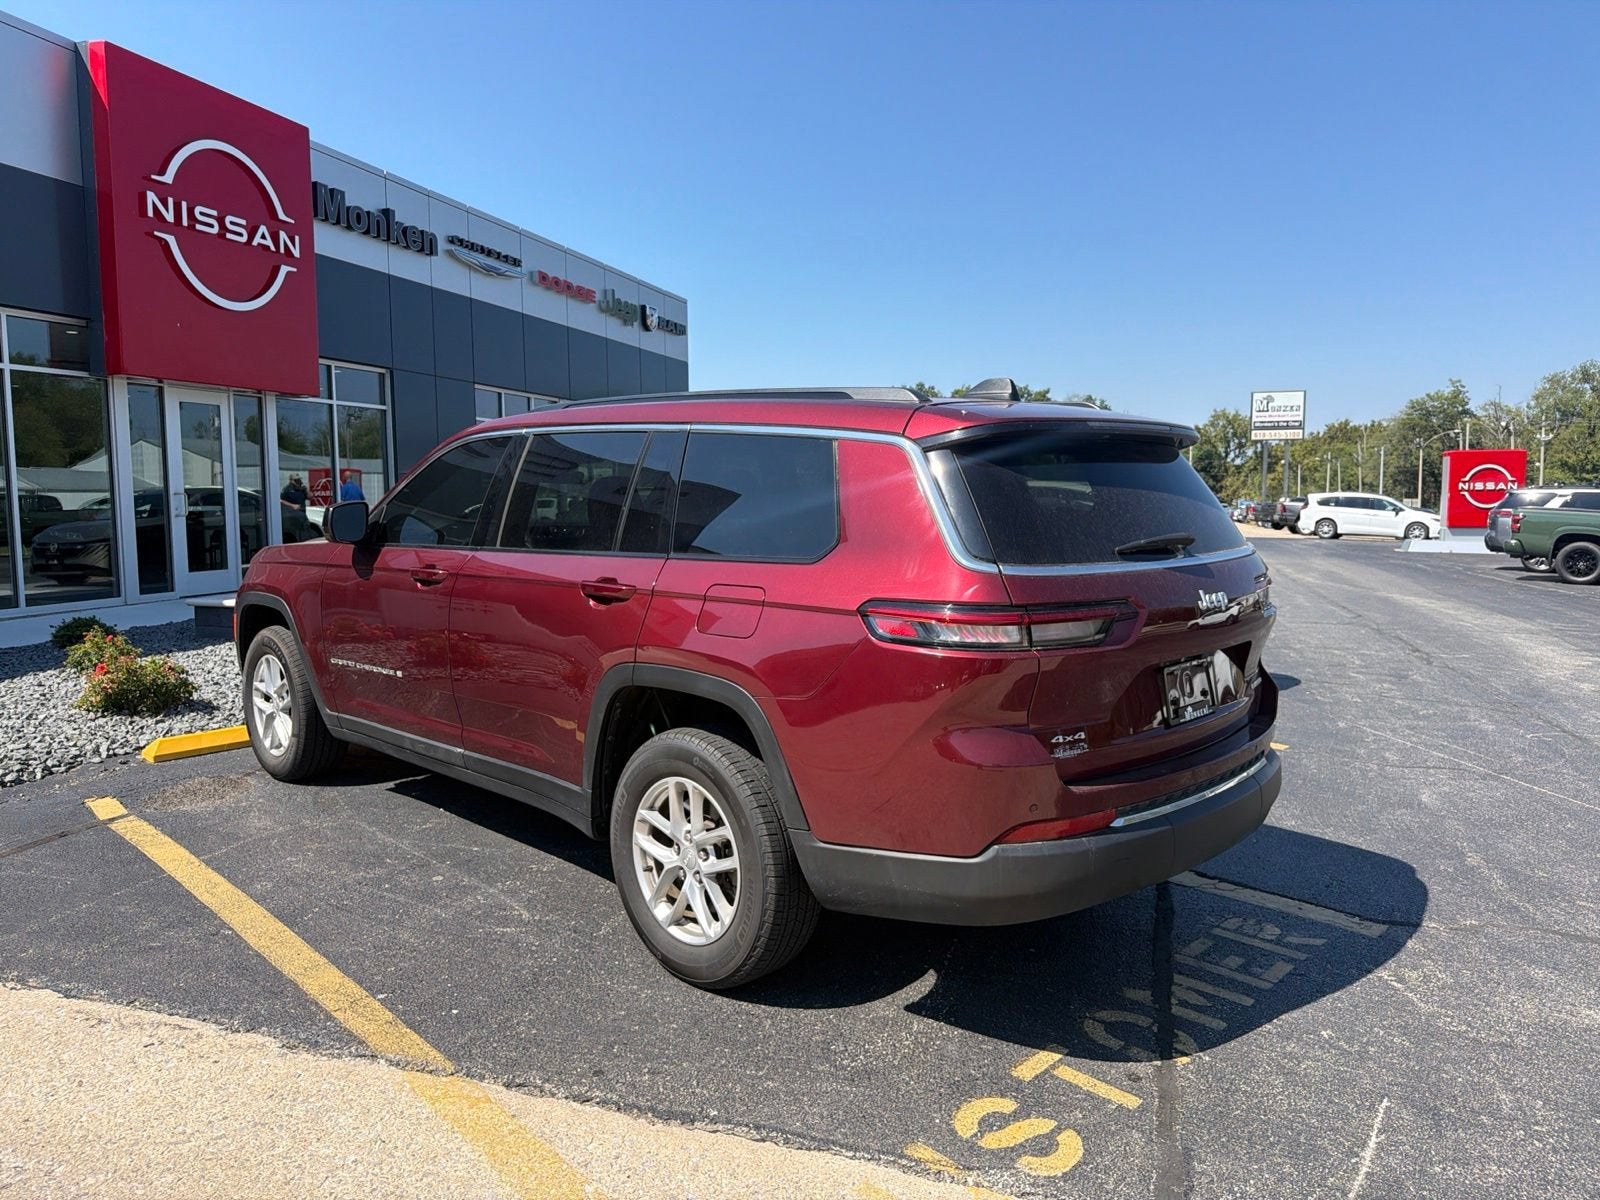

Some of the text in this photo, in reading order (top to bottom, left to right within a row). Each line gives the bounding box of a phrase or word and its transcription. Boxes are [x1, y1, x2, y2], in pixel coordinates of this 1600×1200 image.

[146, 190, 300, 258] NISSAN
[312, 181, 438, 257] Monken
[447, 235, 523, 267] CHRYSLER
[529, 270, 597, 304] DODGE
[598, 288, 638, 328] Jeep
[657, 316, 687, 336] RAM
[1458, 481, 1518, 491] NISSAN
[1198, 589, 1228, 611] Jeep
[1051, 731, 1086, 743] 4x4
